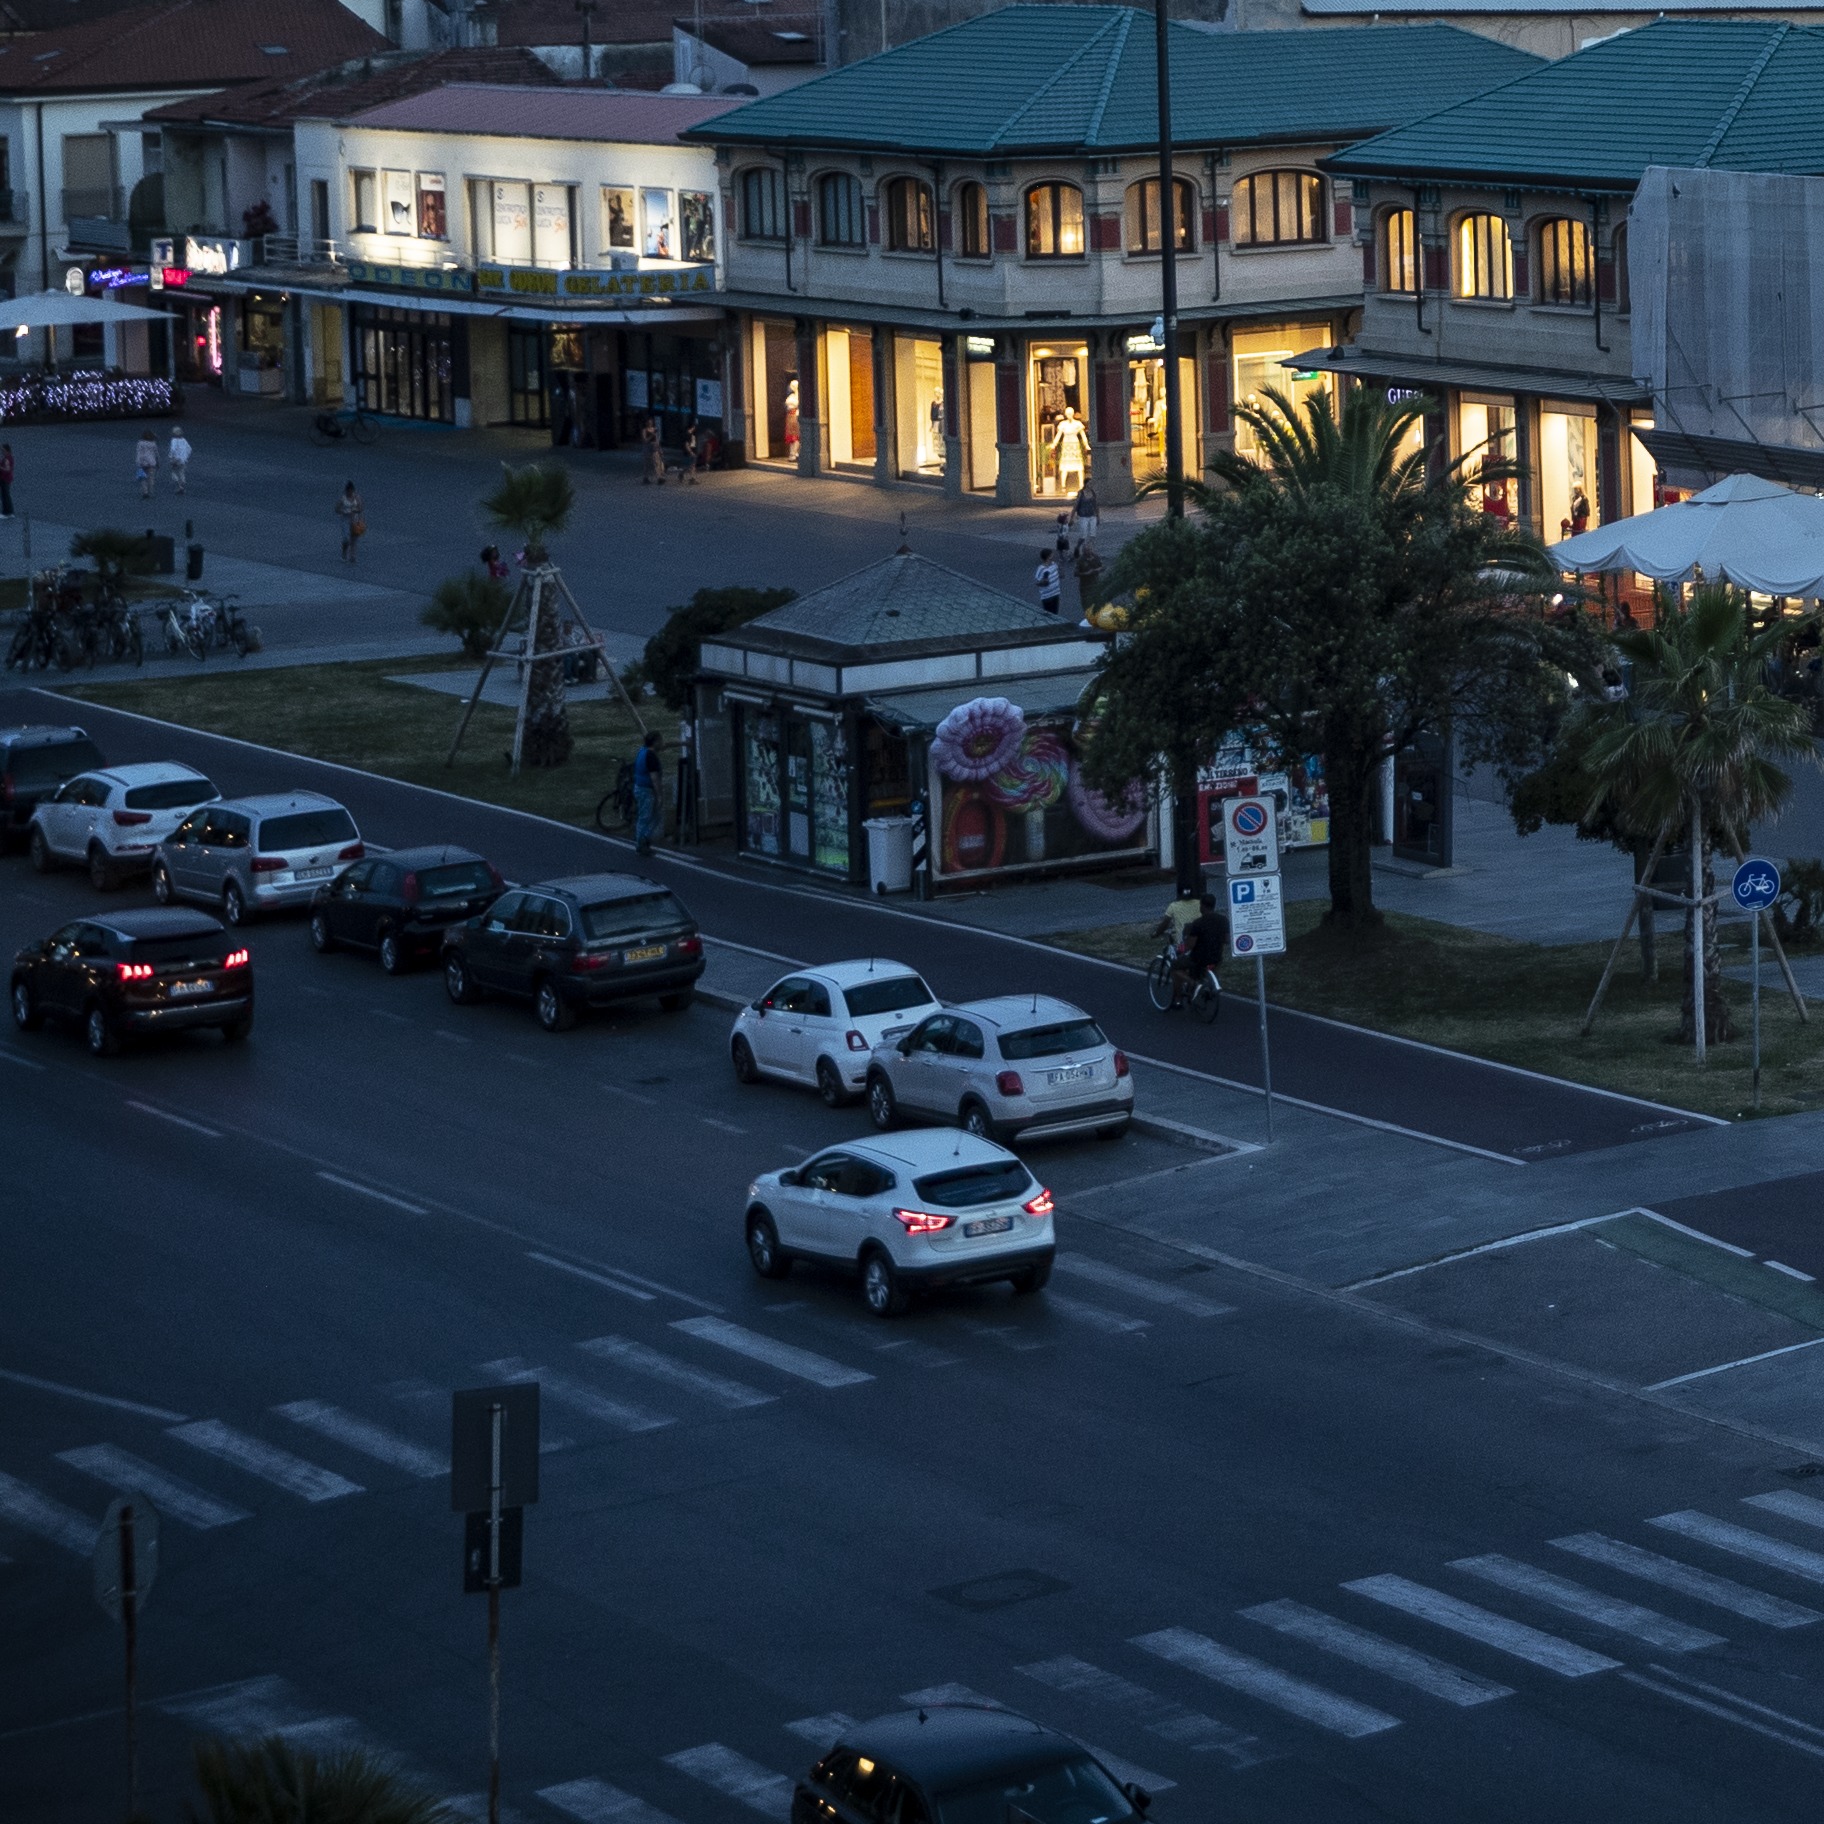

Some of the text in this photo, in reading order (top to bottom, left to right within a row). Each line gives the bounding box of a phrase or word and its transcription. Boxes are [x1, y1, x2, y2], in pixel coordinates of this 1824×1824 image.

[349, 263, 472, 292] ODEON
[564, 271, 711, 296] GELATERIA
[1237, 884, 1250, 902] P
